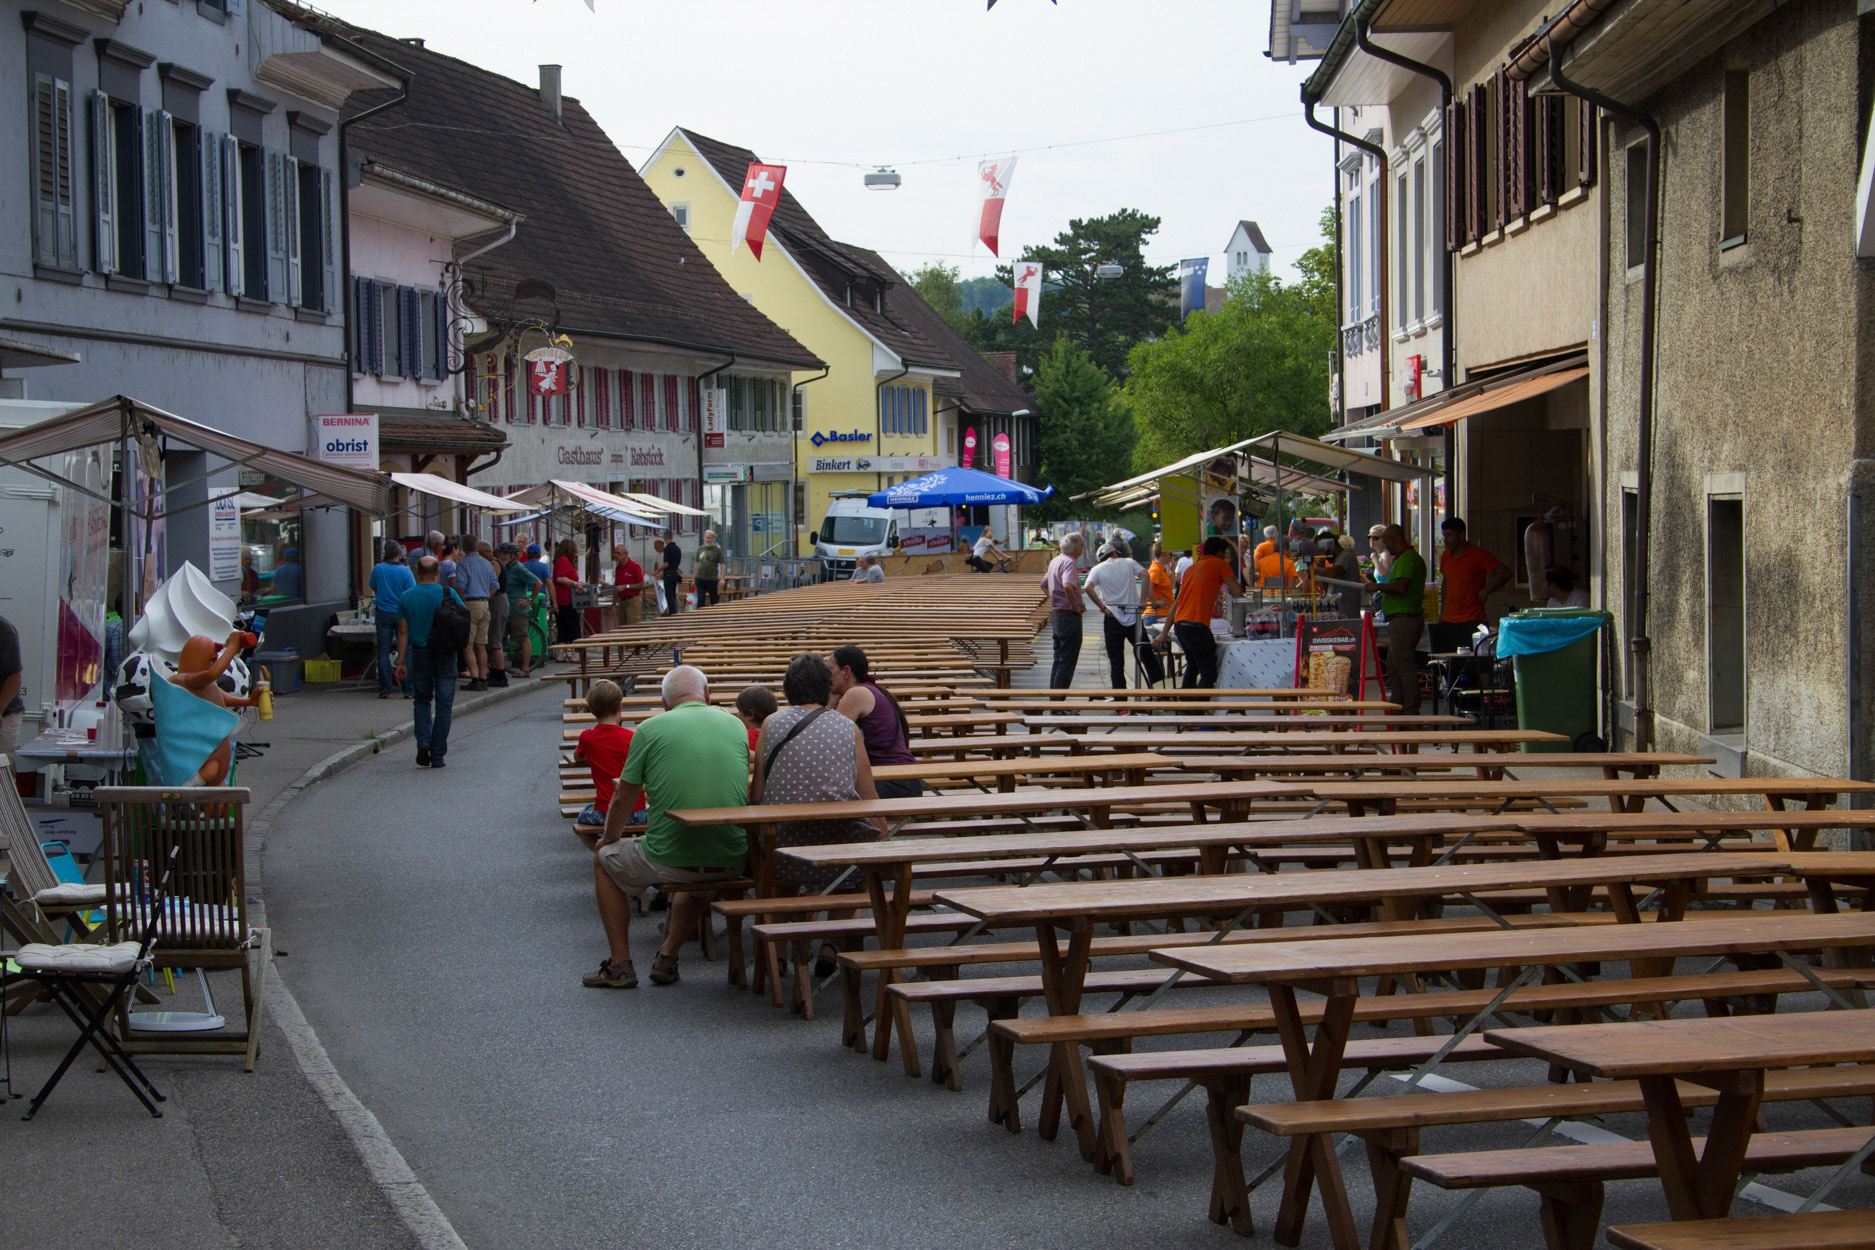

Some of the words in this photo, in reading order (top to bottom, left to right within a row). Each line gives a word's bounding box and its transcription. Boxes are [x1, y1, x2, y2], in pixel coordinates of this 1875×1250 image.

[527, 349, 570, 361] CONFISEUR
[707, 391, 715, 431] LadyForm
[323, 418, 369, 426] BERNINA
[829, 429, 872, 442] Basler
[326, 438, 368, 452] obrist
[557, 445, 602, 465] Gasthaus
[630, 447, 664, 466] Rebstock
[815, 459, 851, 471] Binkert
[965, 493, 1006, 501] henniez.ch
[903, 537, 923, 547] rivella
[929, 537, 948, 546] rivella
[1312, 636, 1356, 644] SWISSKEBAB.ch
